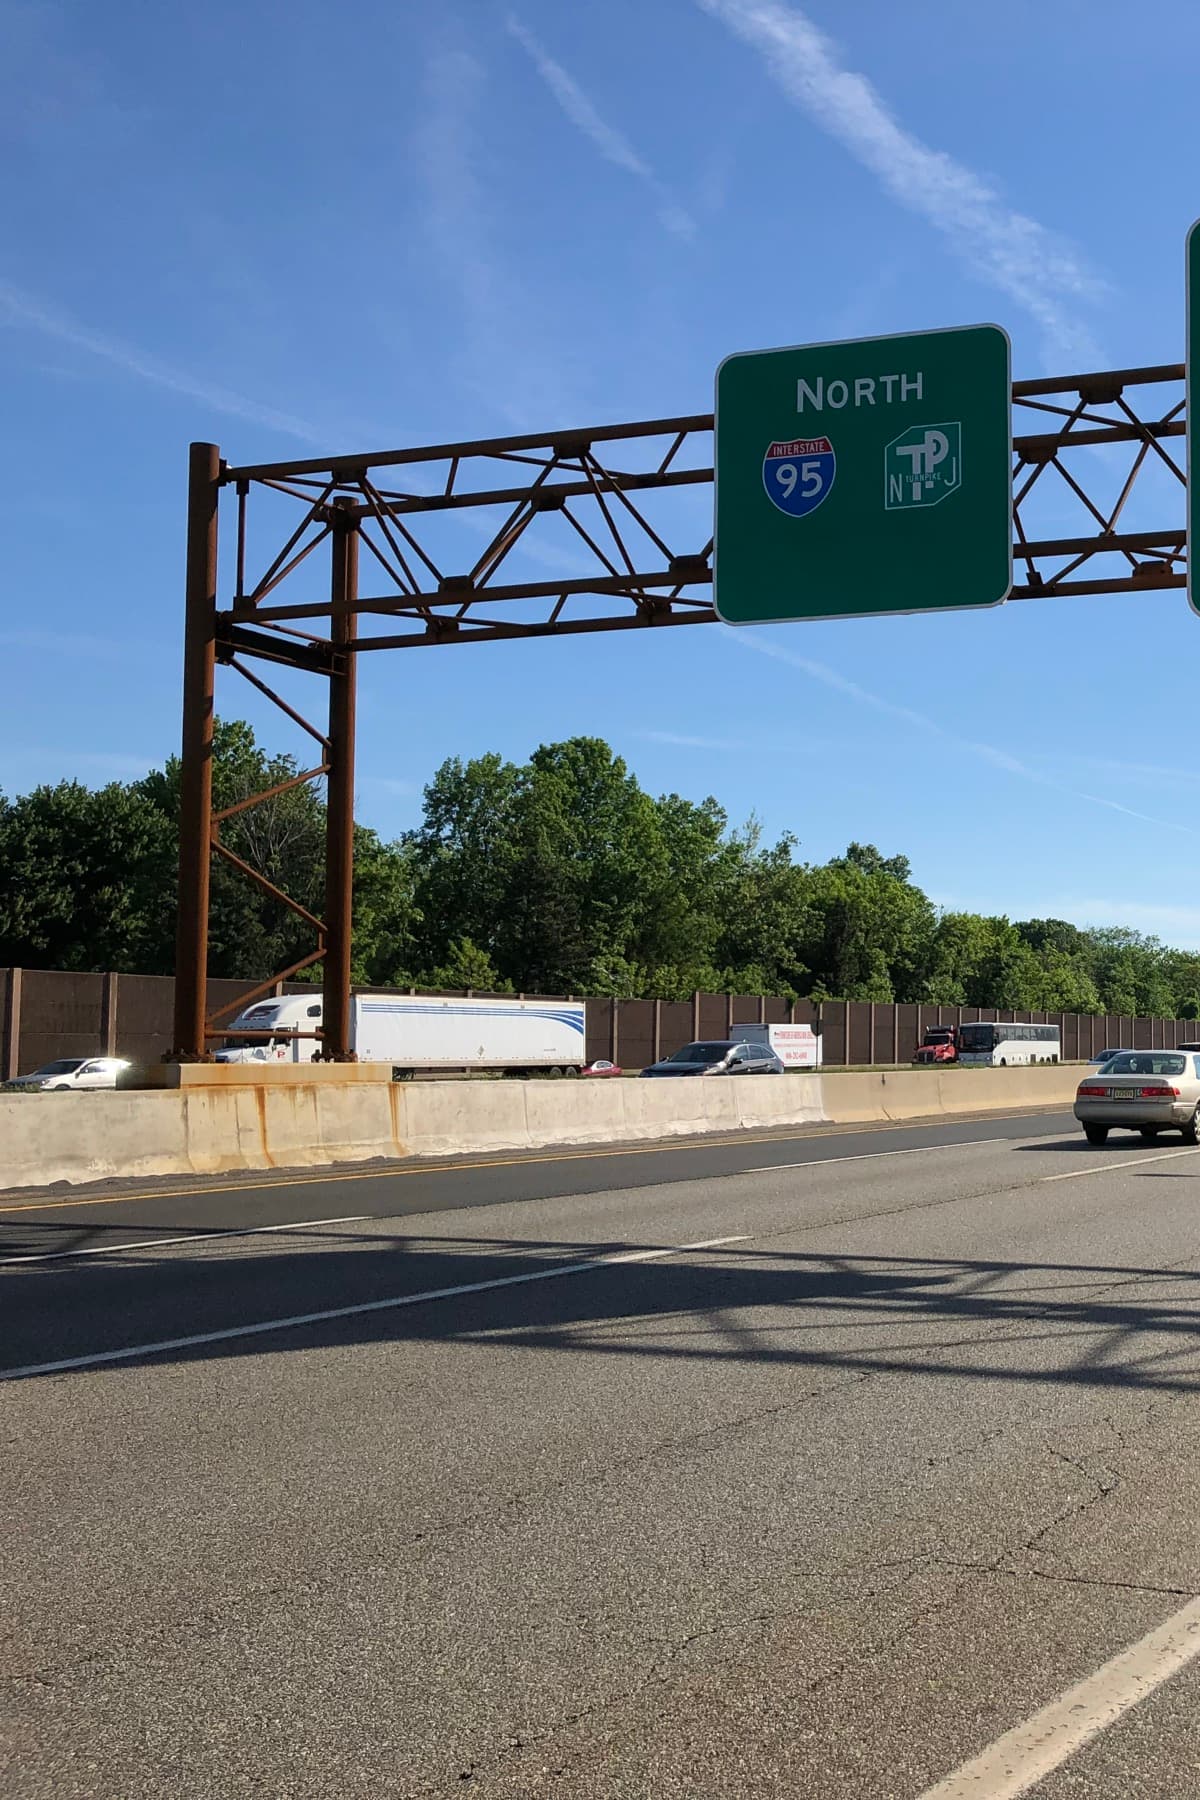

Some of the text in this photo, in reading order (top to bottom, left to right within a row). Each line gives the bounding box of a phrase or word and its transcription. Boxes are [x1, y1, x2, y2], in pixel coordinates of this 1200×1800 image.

[796, 371, 923, 413] NORTH
[773, 441, 825, 456] INTERSTATE
[775, 461, 823, 499] 95
